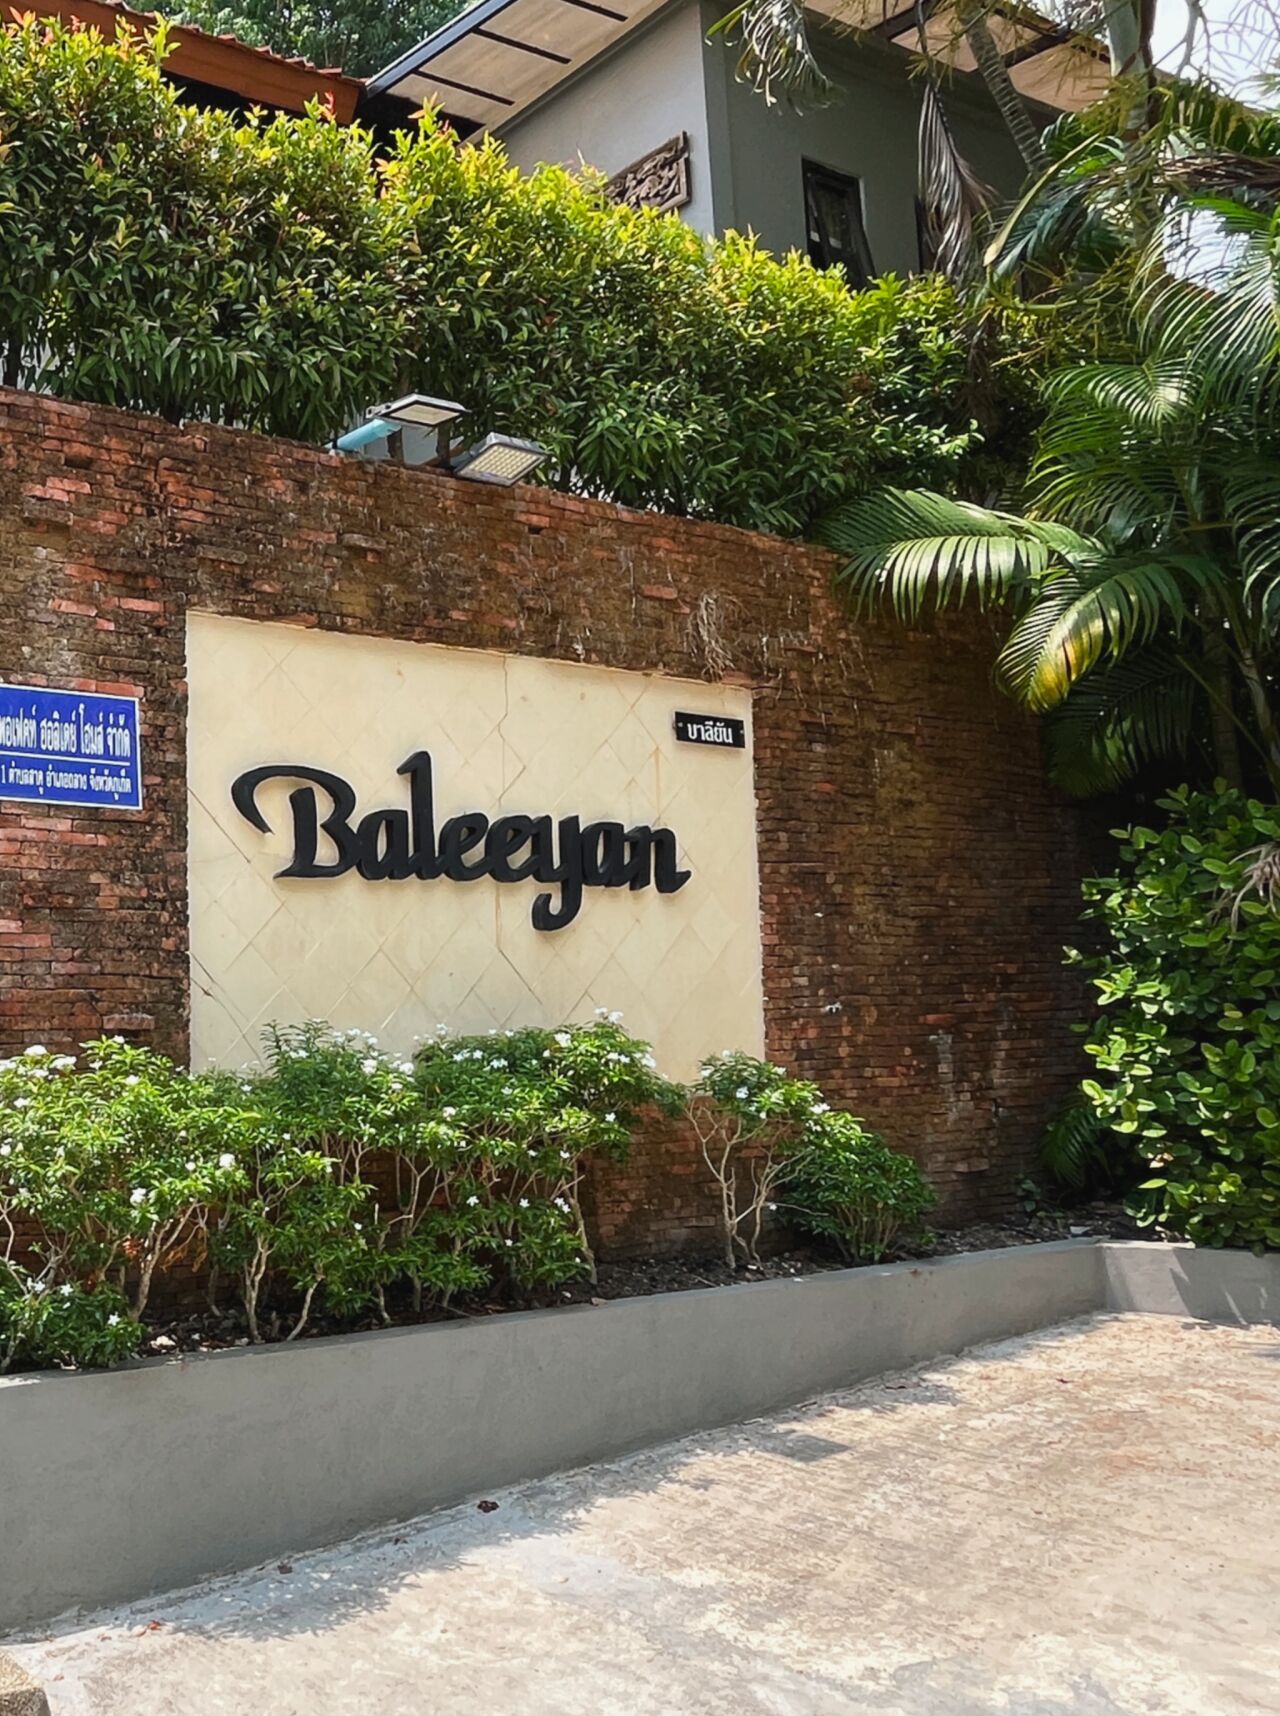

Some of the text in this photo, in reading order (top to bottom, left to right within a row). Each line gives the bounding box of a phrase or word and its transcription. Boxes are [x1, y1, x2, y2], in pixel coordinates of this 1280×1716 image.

[39, 709, 78, 754] ฮอลิเดย์
[78, 703, 104, 756] โฮมส์
[105, 712, 131, 758] จำกัด
[1, 764, 6, 784] 1
[8, 760, 44, 795] ตำบลสาคู
[45, 763, 87, 790] อำเภอถลาง
[89, 767, 132, 801] จังหวัดภูเก็ต
[230, 751, 692, 931] Baleeyan
